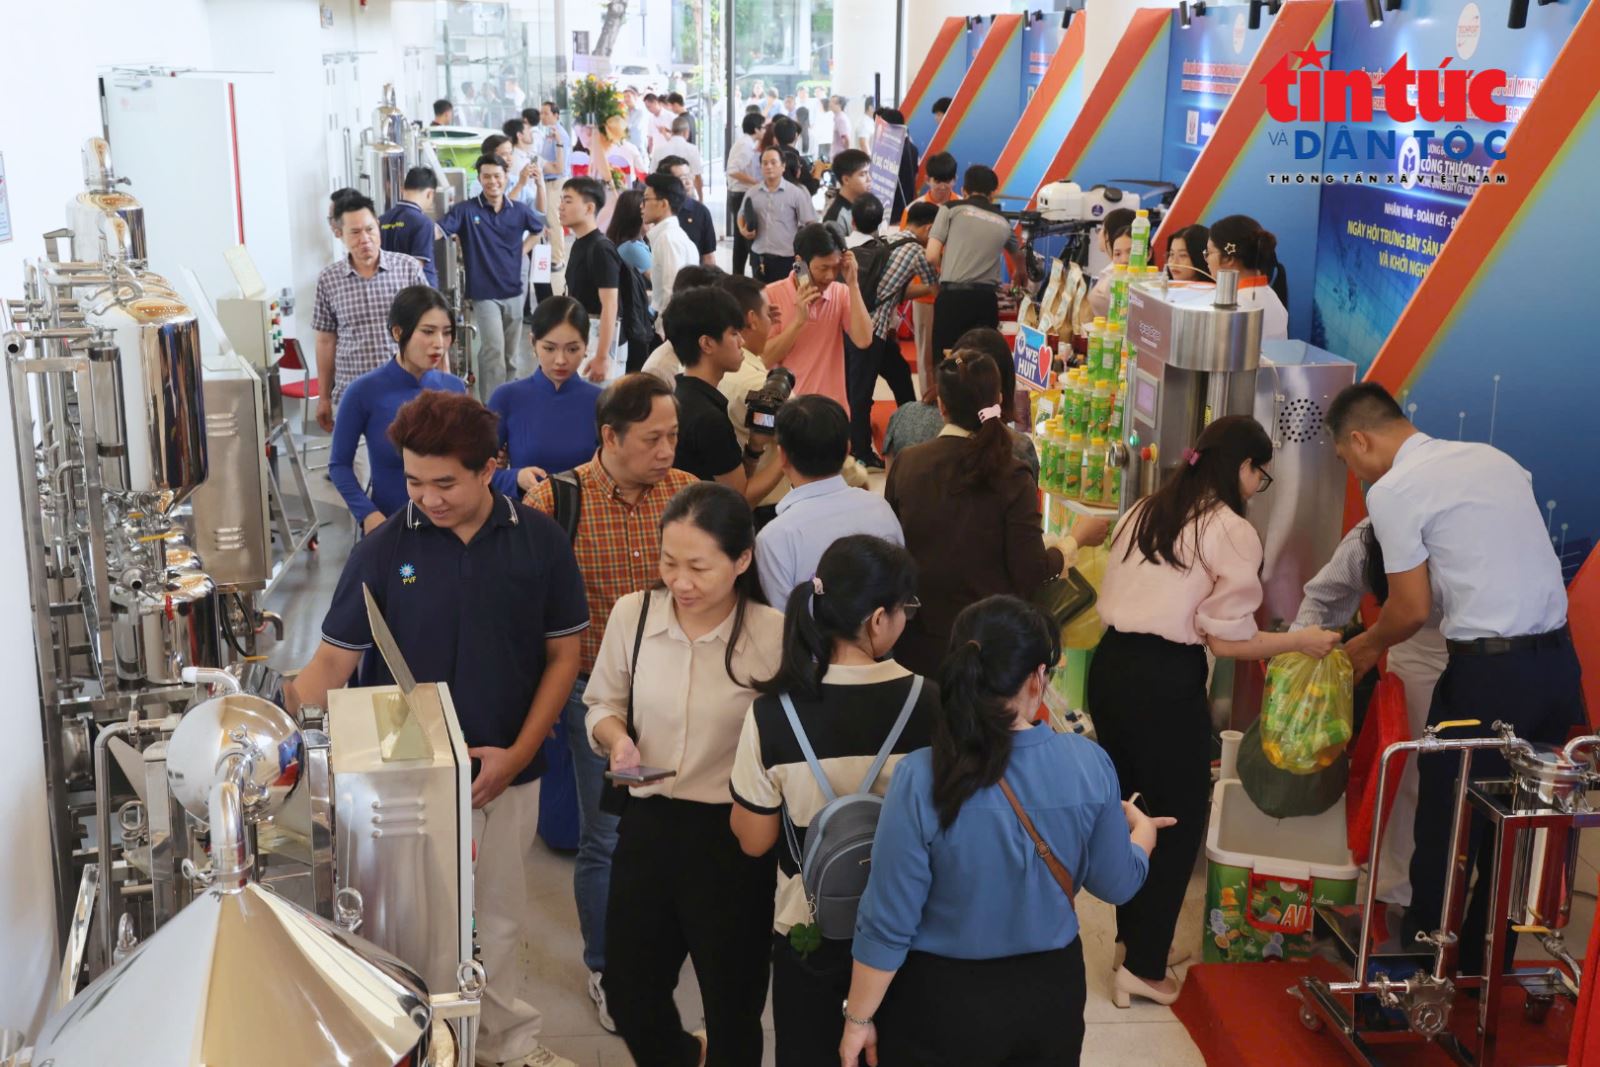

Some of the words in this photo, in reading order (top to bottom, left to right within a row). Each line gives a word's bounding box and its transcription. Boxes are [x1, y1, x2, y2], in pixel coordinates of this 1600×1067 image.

[1420, 154, 1443, 174] CÔNG
[1444, 160, 1481, 179] THƯƠNG
[1384, 202, 1401, 217] NHÂN
[1400, 204, 1414, 220] VĂN
[1416, 208, 1434, 225] ĐOÀN
[1435, 211, 1448, 228] KẾT
[1347, 220, 1365, 238] NGÀY
[1366, 223, 1380, 245] HỘI
[1380, 228, 1405, 248] TRƯNG
[1406, 232, 1422, 253] BÀY
[1421, 235, 1439, 257] SẢN
[1379, 249, 1388, 267] VÀ
[1389, 253, 1409, 274] KHỞI
[1025, 346, 1038, 364] WE
[1018, 357, 1037, 381] HUIT
